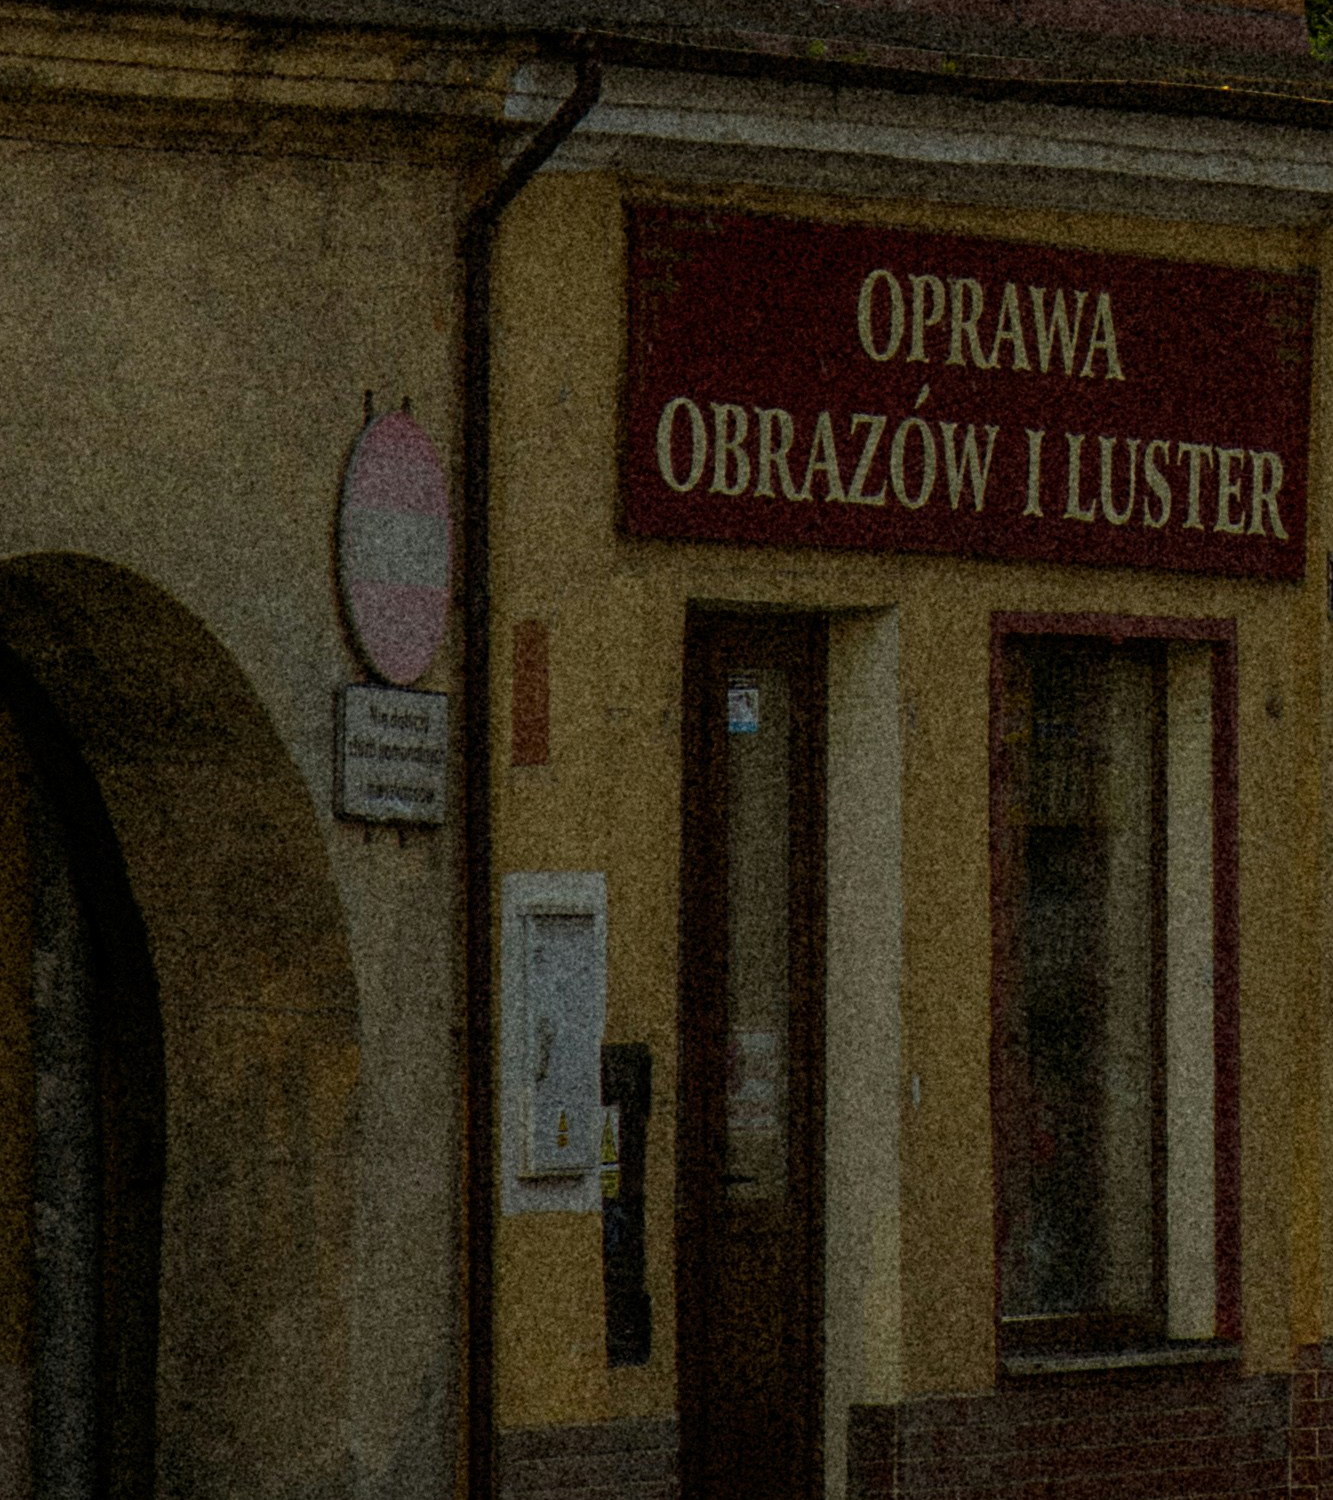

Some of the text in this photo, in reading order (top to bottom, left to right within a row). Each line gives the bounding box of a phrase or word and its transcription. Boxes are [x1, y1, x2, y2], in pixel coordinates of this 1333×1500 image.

[857, 268, 1126, 381] OPRAWA
[656, 384, 1290, 540] OBRAZÓW I LUSTER
